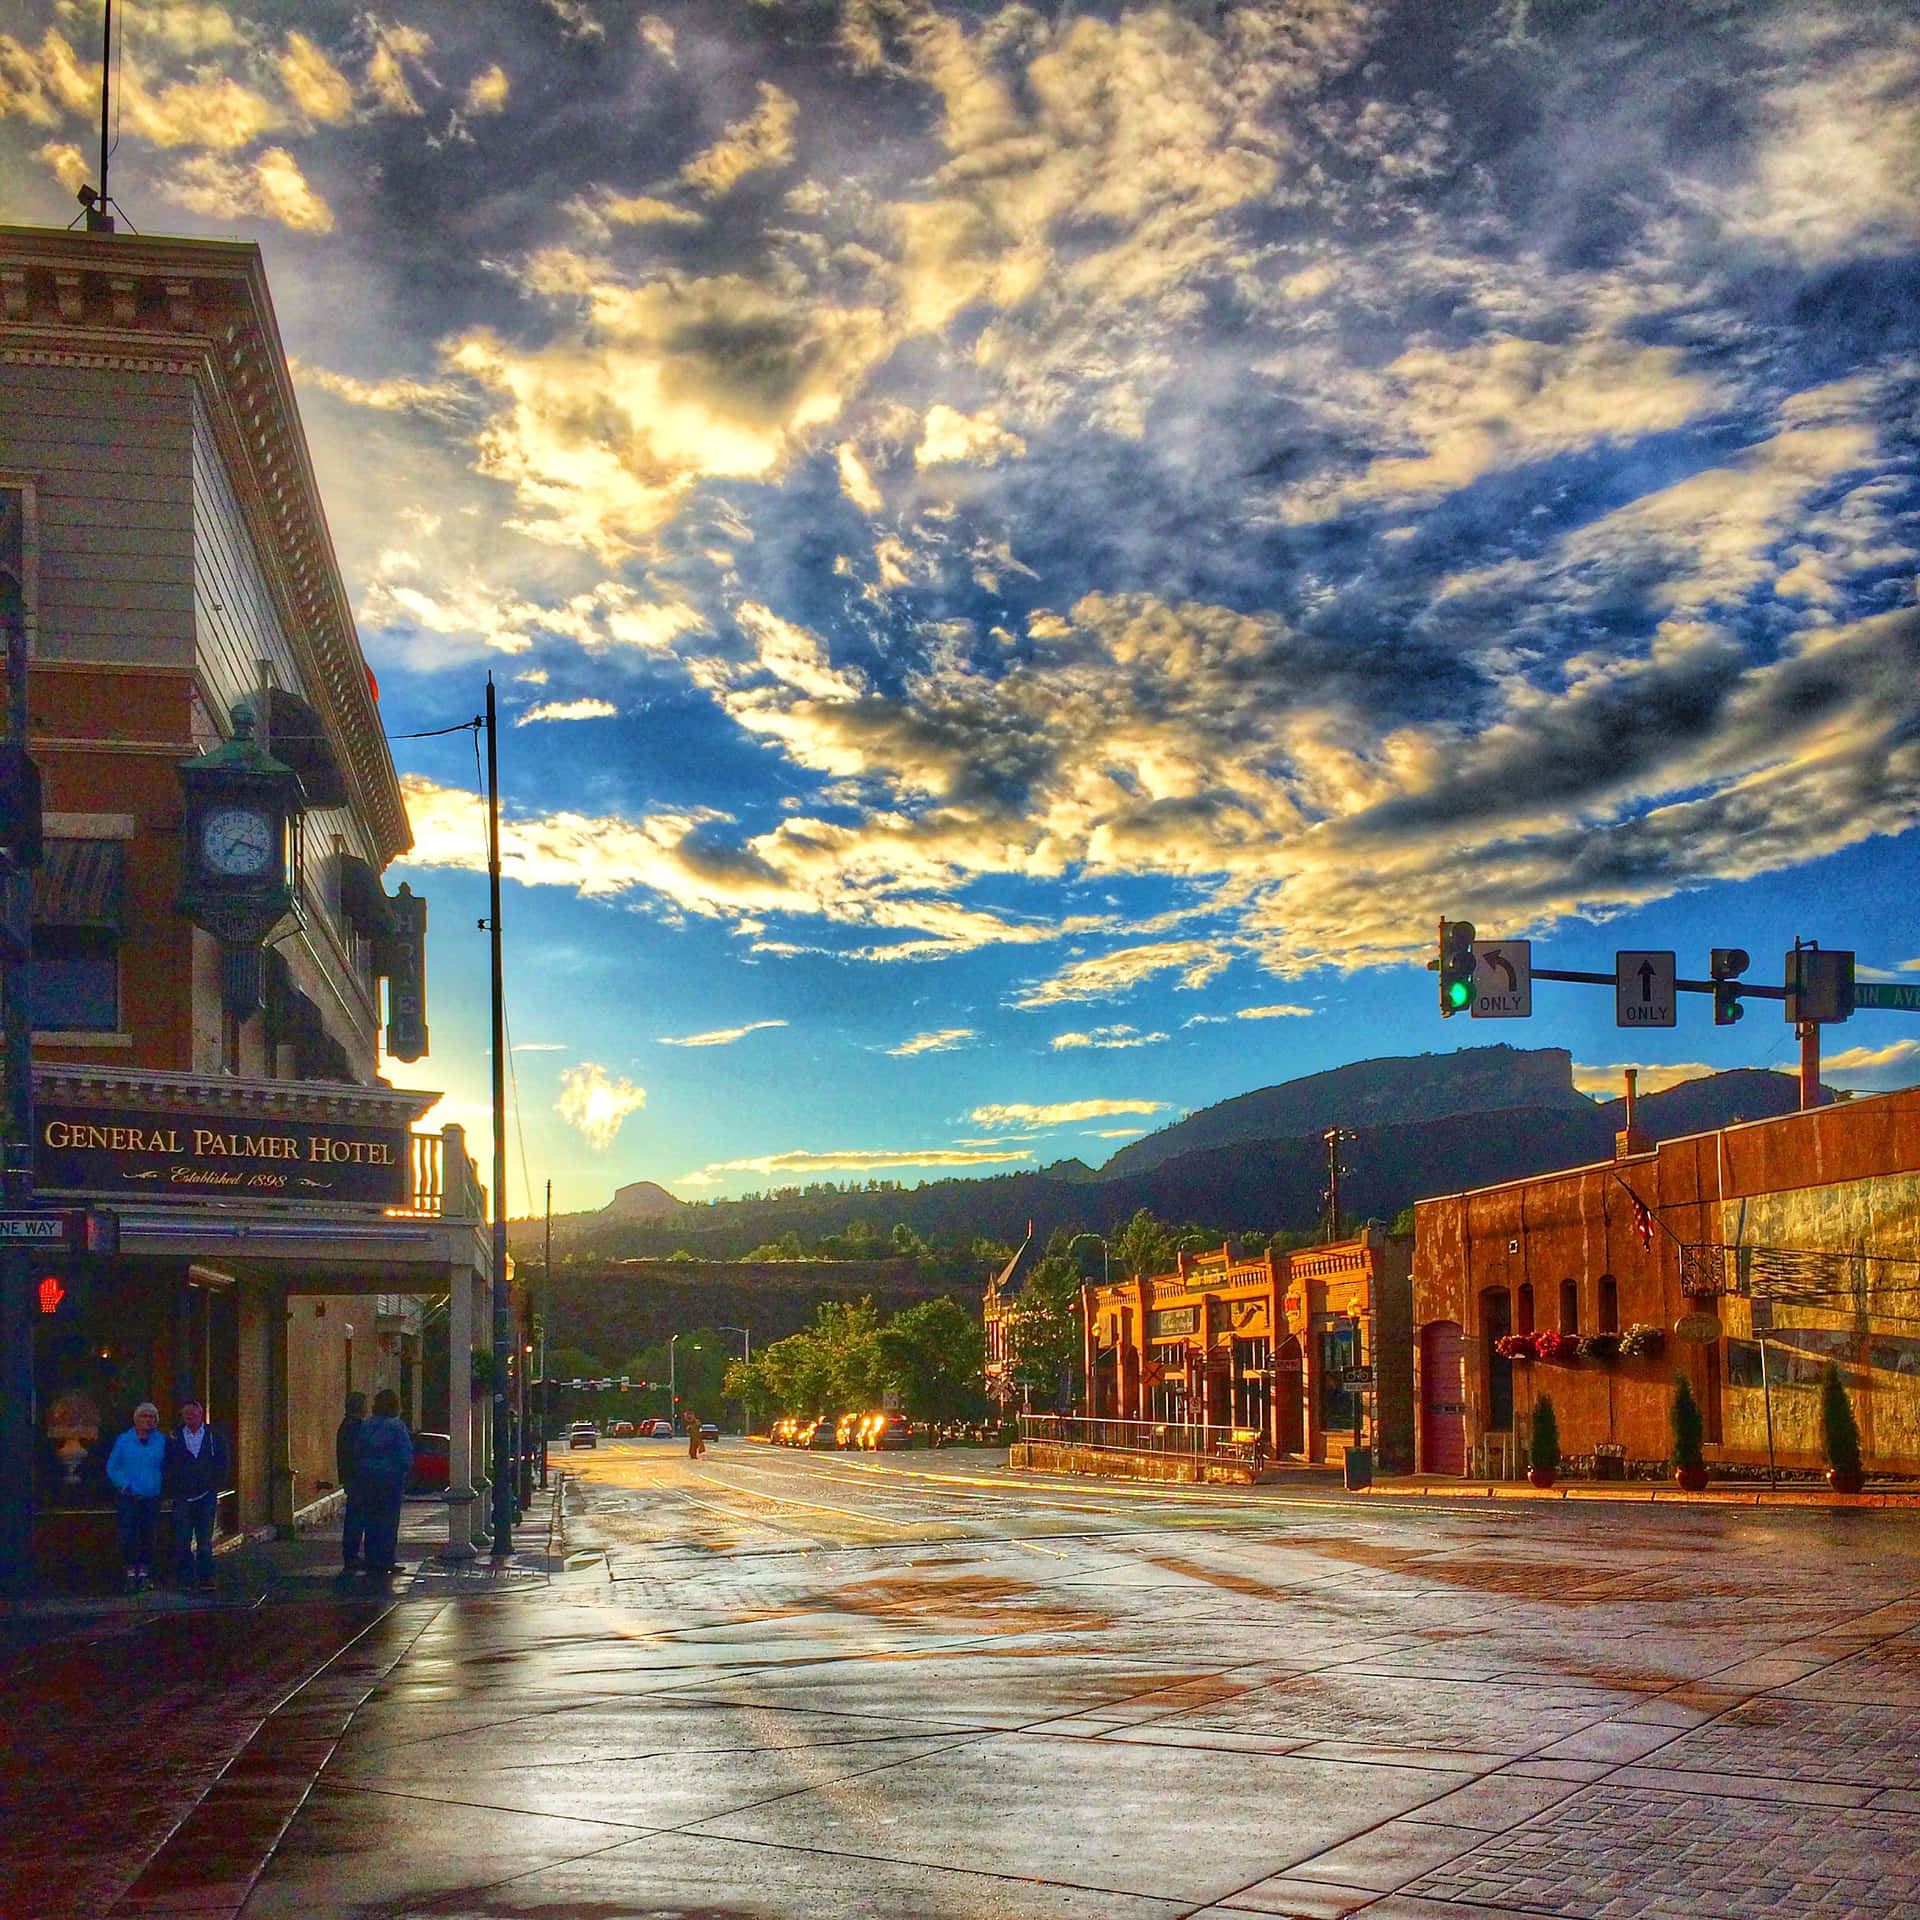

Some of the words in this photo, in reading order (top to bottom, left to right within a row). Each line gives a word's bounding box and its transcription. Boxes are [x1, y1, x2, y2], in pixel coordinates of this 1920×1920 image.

[1480, 996, 1522, 1011] ONLY
[1854, 985, 1880, 1006] AIN
[1626, 1006, 1669, 1021] ONLY
[46, 1121, 185, 1153] GENERAL
[193, 1129, 300, 1160] PALMER
[308, 1136, 395, 1166] HOTEL
[170, 1166, 244, 1185] Established
[247, 1174, 288, 1189] 1898
[0, 1221, 18, 1235] NE
[25, 1221, 56, 1235] WAY
